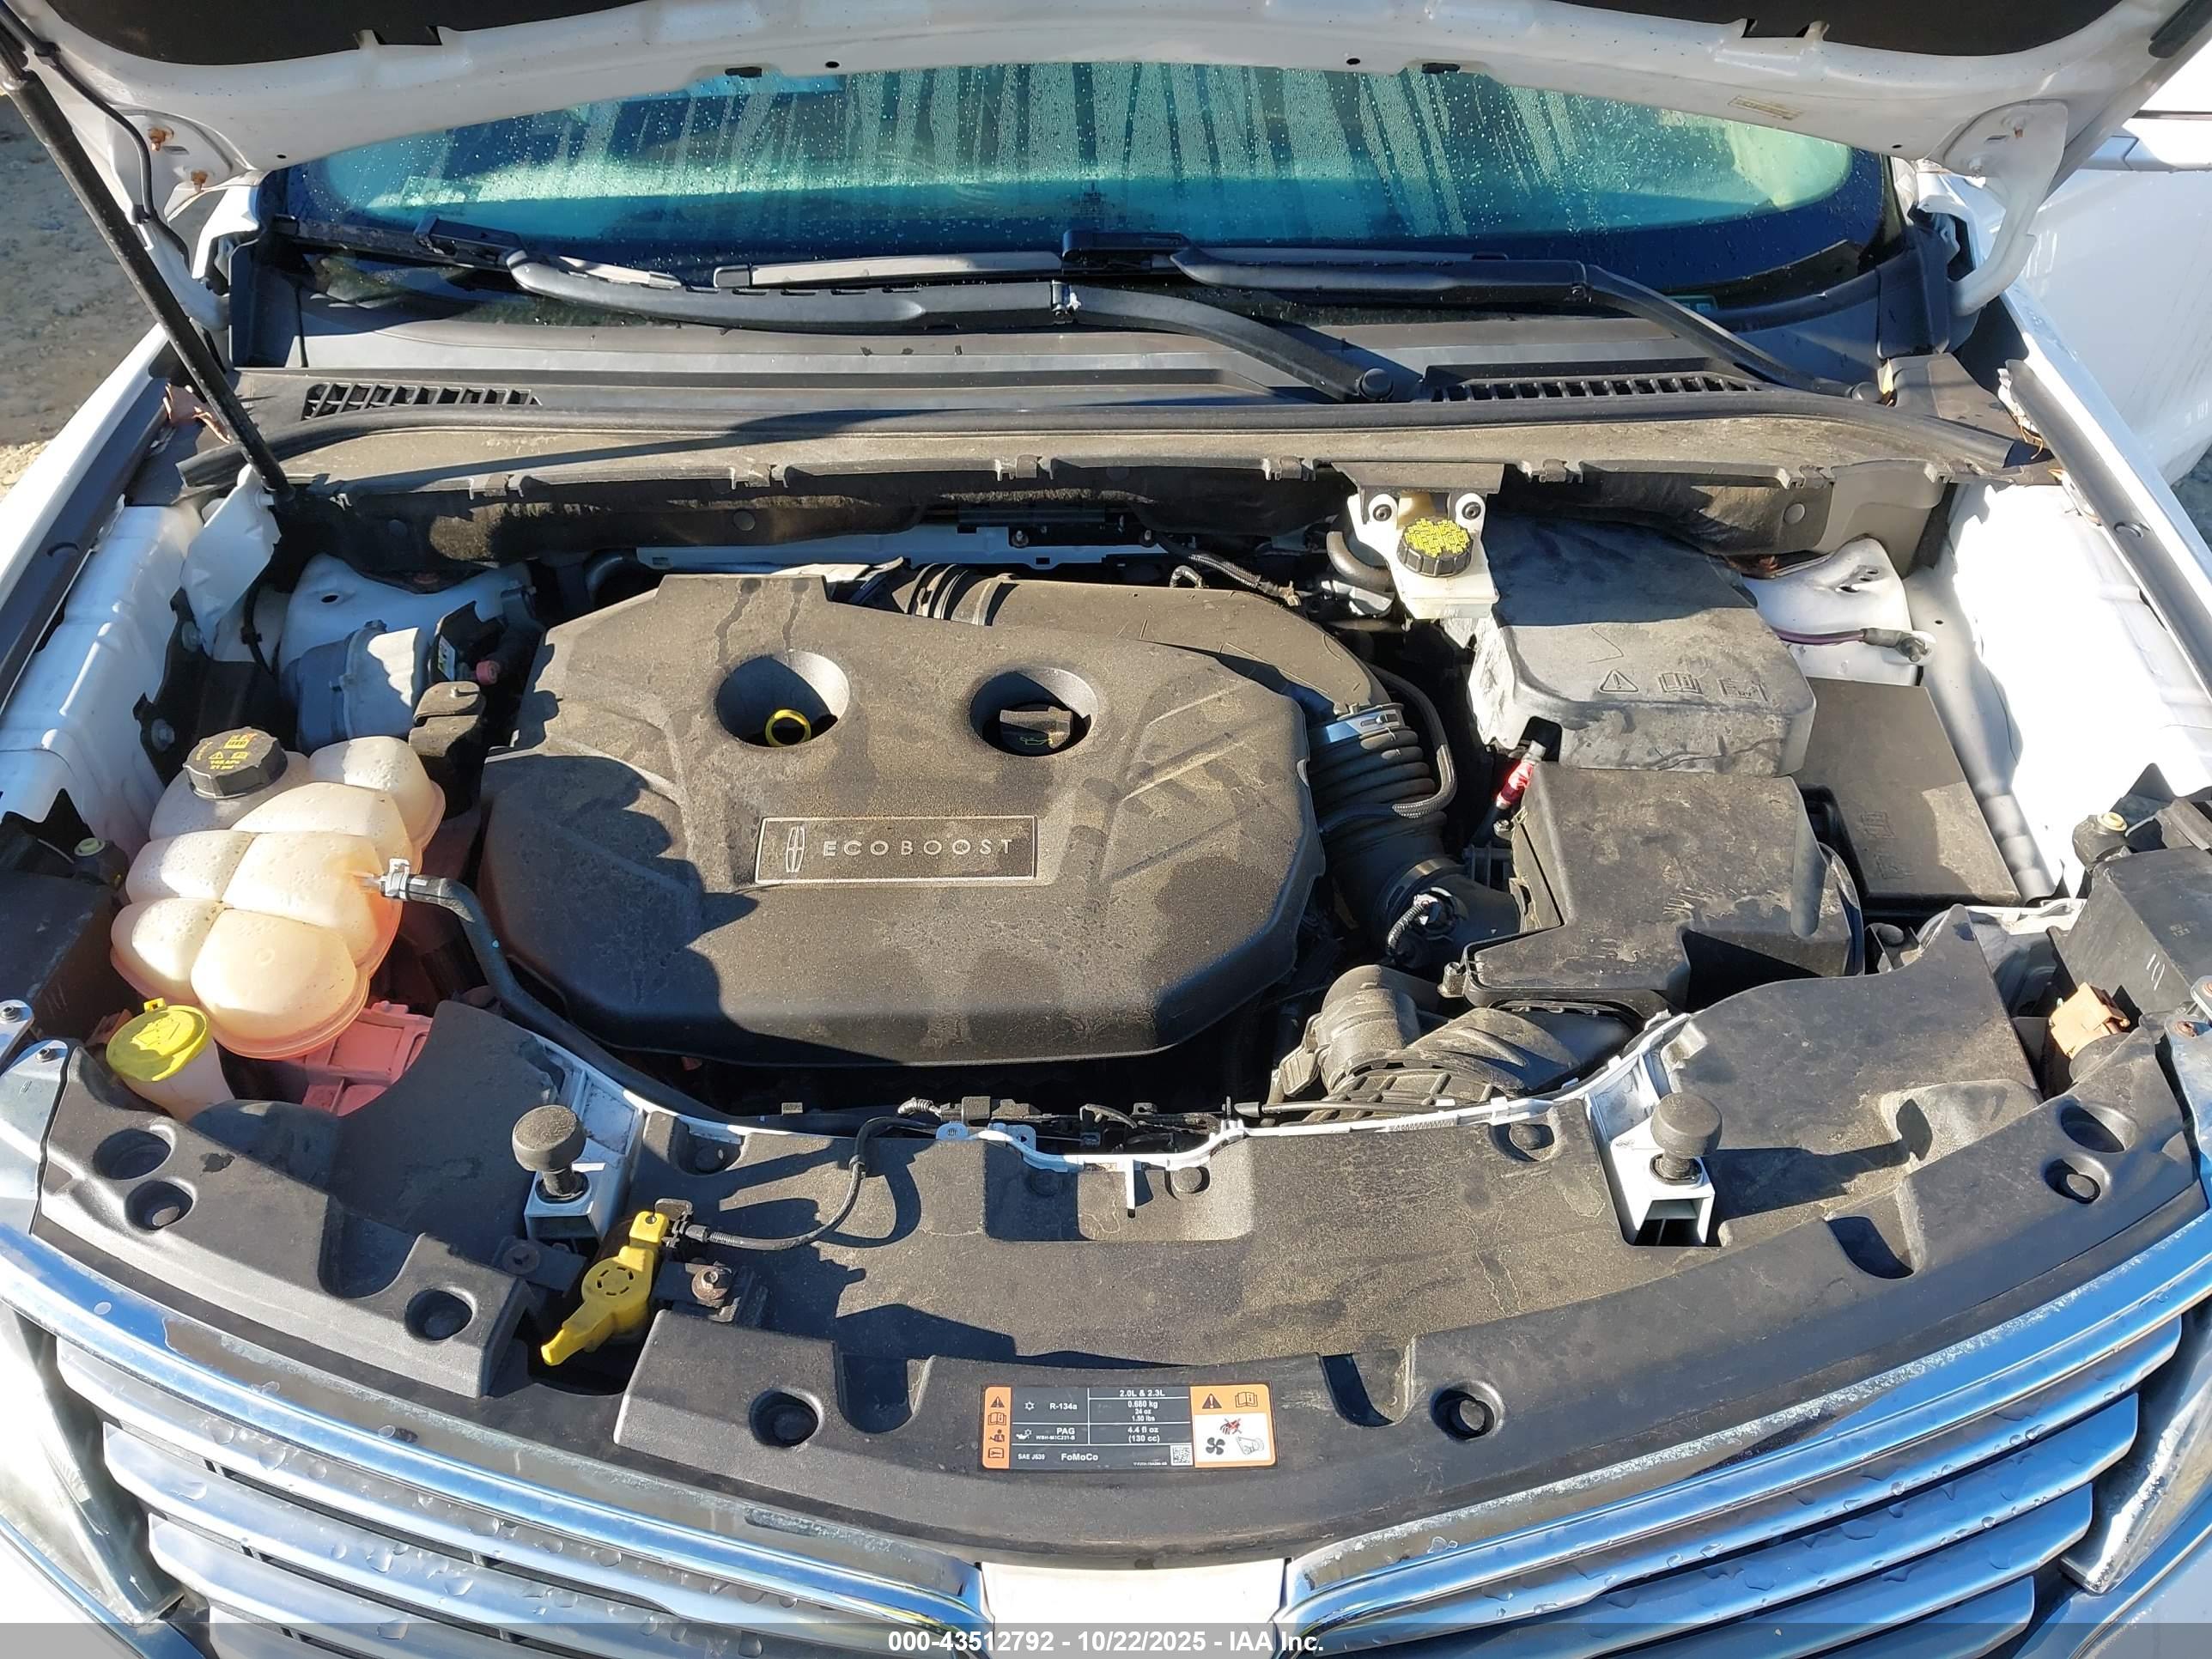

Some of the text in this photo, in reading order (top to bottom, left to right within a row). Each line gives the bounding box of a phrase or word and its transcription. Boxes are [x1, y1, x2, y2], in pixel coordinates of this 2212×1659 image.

[823, 838, 1012, 857] ECOBOOST
[1149, 1401, 1158, 1409] kg
[1128, 1434, 1160, 1443] (130 cc)
